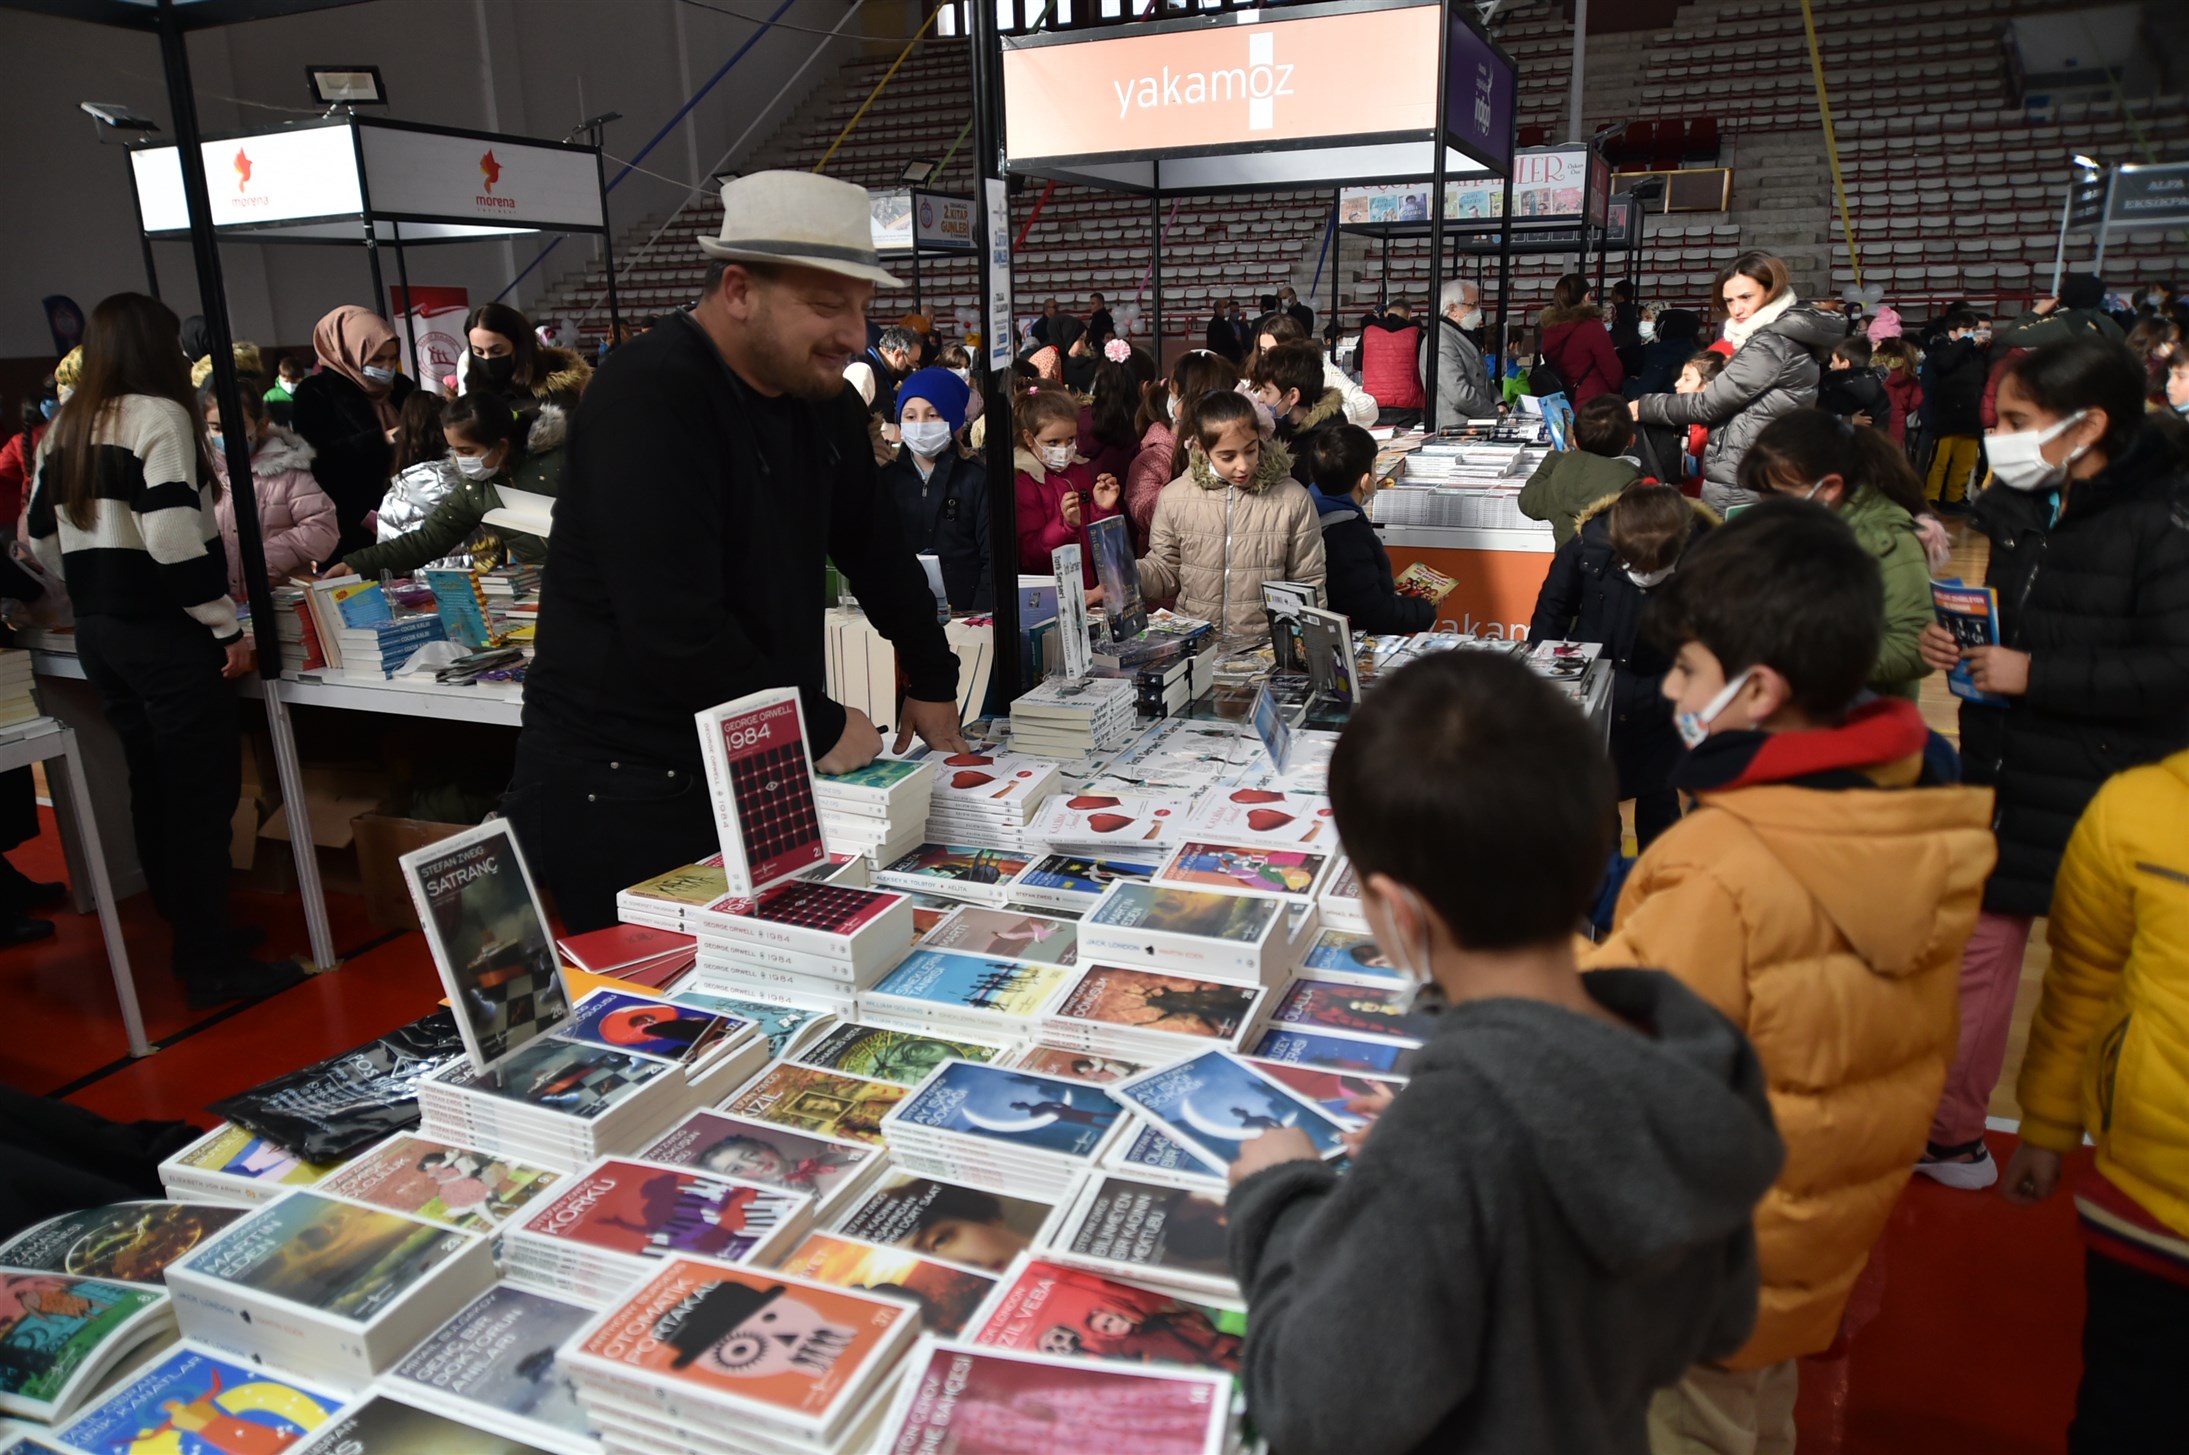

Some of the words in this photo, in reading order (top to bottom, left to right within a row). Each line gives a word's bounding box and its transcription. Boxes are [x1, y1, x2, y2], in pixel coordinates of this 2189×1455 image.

[1114, 63, 1295, 119] yakamoz
[231, 194, 269, 208] morena
[475, 195, 515, 208] morena
[723, 714, 759, 733] GEORGE
[759, 704, 793, 724] ORWELL
[704, 722, 715, 759] GEORGE
[725, 722, 771, 751] 1984
[709, 758, 721, 786] ORWELL
[420, 857, 457, 879] STEFAN
[456, 845, 485, 863] ZWEIG
[426, 855, 499, 897] SATRANÇ
[876, 875, 902, 885] ALEKSEY
[909, 879, 936, 889] TOLSTOY
[1015, 891, 1036, 899] STEFAN
[1107, 896, 1135, 925] MARTIN
[1121, 907, 1144, 928] EDEN
[703, 920, 730, 932] GEORGE
[730, 924, 755, 937] ORWELL
[766, 930, 791, 943] 1984
[1085, 939, 1107, 948] JACK
[1107, 941, 1140, 952] LONDON
[704, 941, 729, 953] GEORGE
[729, 945, 756, 958] ORWELL
[766, 952, 792, 965] 1984
[703, 962, 730, 974] GEORGE
[730, 965, 757, 978] ORWELL
[768, 973, 794, 985] 1984
[703, 981, 730, 993] GEORGE
[730, 985, 756, 998] ORWELL
[766, 992, 792, 1004] 1984
[865, 999, 892, 1010] WILLIAM
[892, 1003, 924, 1015] GOLDING
[1284, 988, 1314, 1022] OLALLA
[756, 1072, 781, 1094] ZWEIG
[1128, 1075, 1165, 1095] STEFAN
[1136, 1085, 1156, 1103] AY
[900, 1099, 927, 1121] STEFAN
[914, 1108, 933, 1125] AY
[540, 1177, 618, 1235] KORKU
[919, 1182, 944, 1209] SAAT
[528, 1197, 567, 1230] STEFAN
[867, 1197, 901, 1229] KADININ
[1073, 1223, 1094, 1254] STEFAN
[1089, 1198, 1111, 1226] ZWEIG
[1090, 1190, 1134, 1257] BİLİNMEYEN
[1110, 1236, 1132, 1261] BİR
[1122, 1193, 1153, 1239] KADININ
[202, 1219, 284, 1275] MARTIN
[1130, 1208, 1168, 1264] MEKTUBU
[219, 1237, 278, 1278] EDEN
[177, 1287, 199, 1303] JACK
[199, 1295, 235, 1316] LONDON
[992, 1286, 1026, 1329] LONDON
[1018, 1276, 1057, 1322] VEBA
[602, 1276, 695, 1361] OTOMATİK
[624, 1277, 724, 1365] PORTAKAL
[415, 1339, 465, 1382] GENÇ
[458, 1313, 494, 1341] BİR
[431, 1307, 524, 1387] DOKTORUN
[451, 1331, 518, 1394] ANILARI
[930, 1354, 974, 1427] BAHÇESİ
